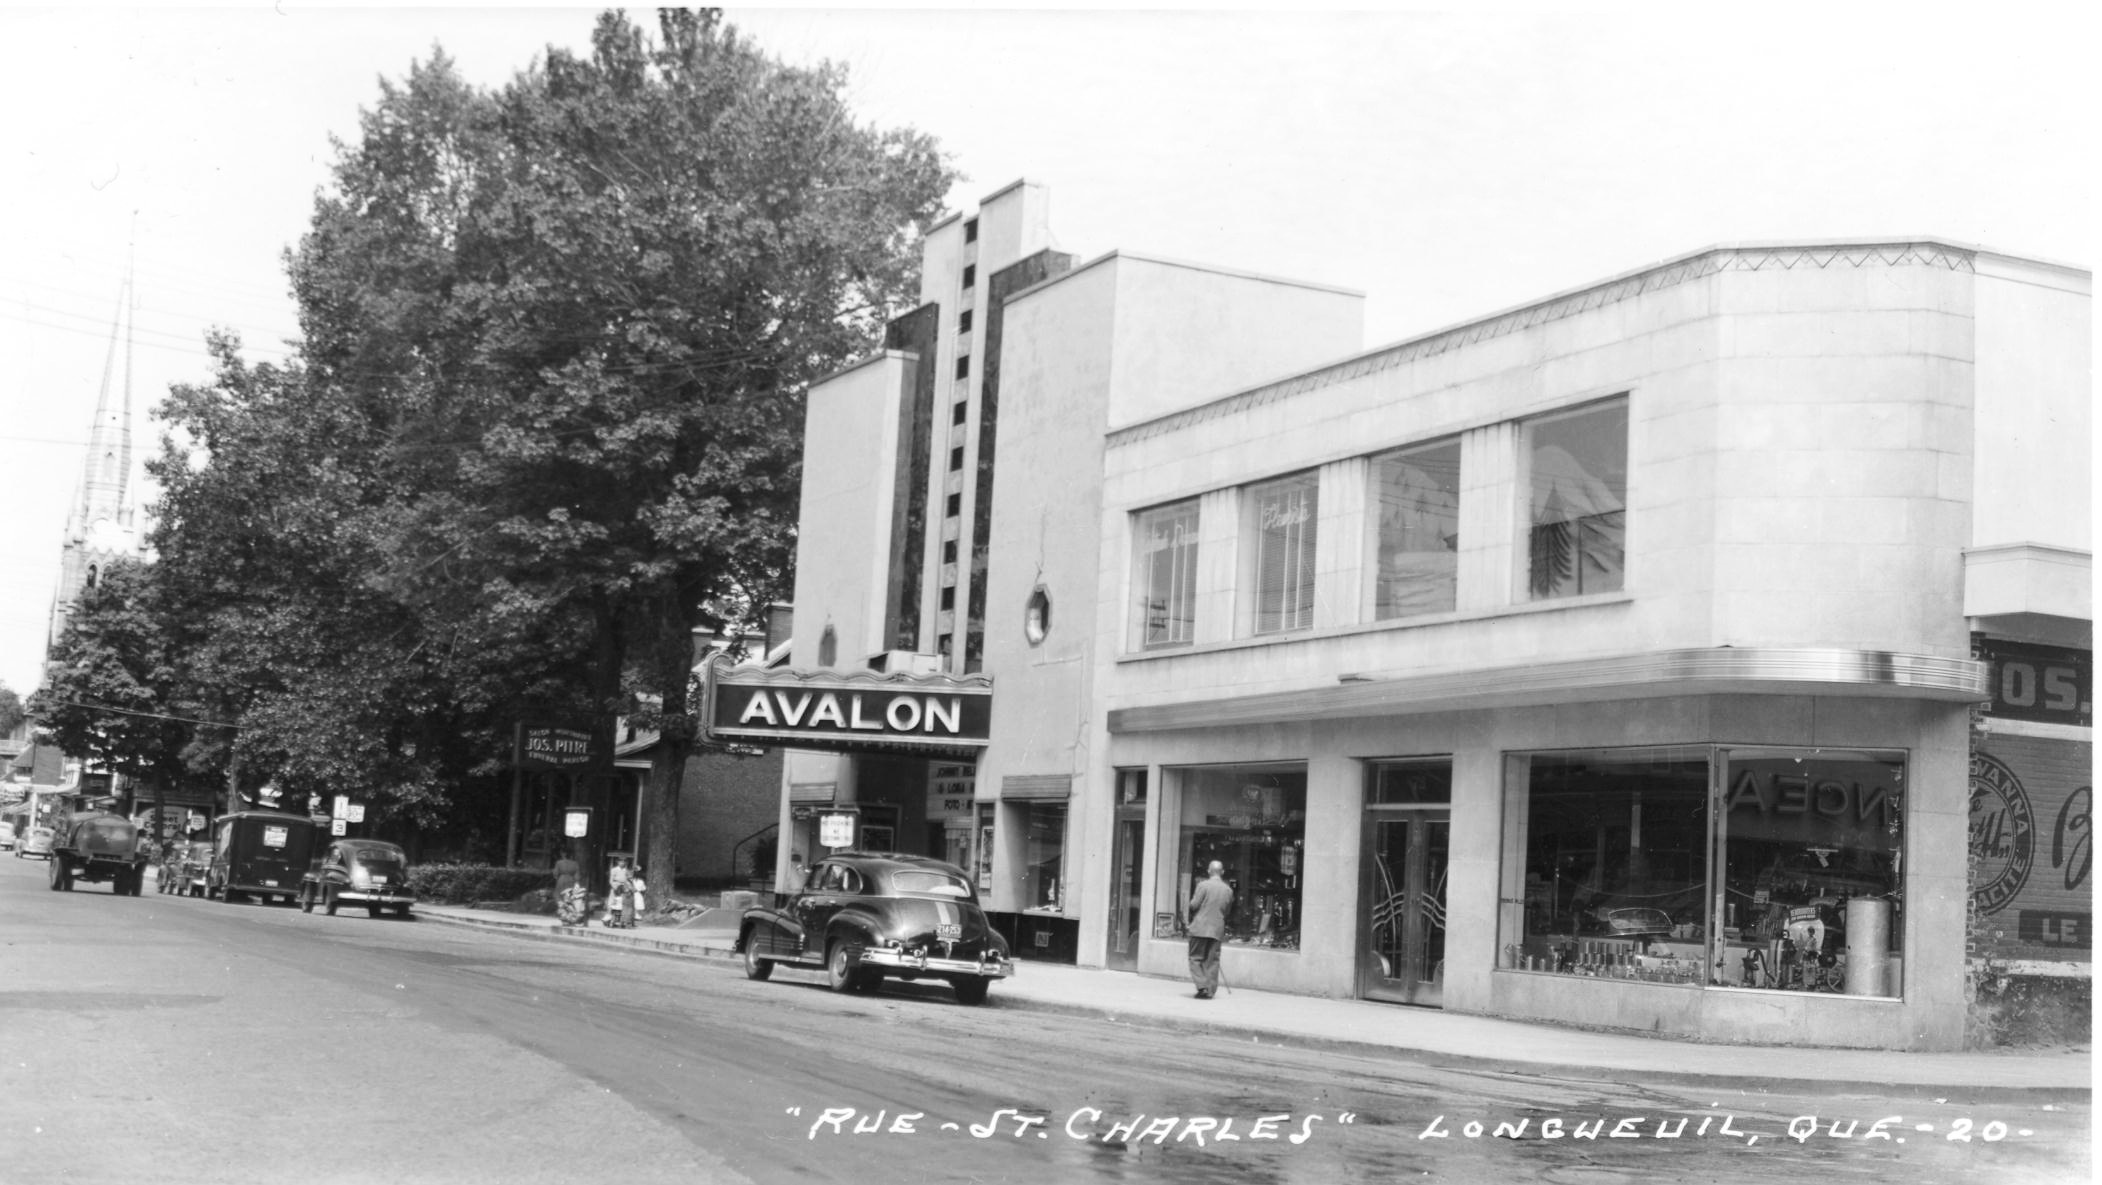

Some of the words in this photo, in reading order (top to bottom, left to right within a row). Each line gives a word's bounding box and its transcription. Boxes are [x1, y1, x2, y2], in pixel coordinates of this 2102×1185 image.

[739, 689, 961, 734] AVALON
[525, 738, 553, 752] JOS.
[2042, 917, 2079, 943] LE
